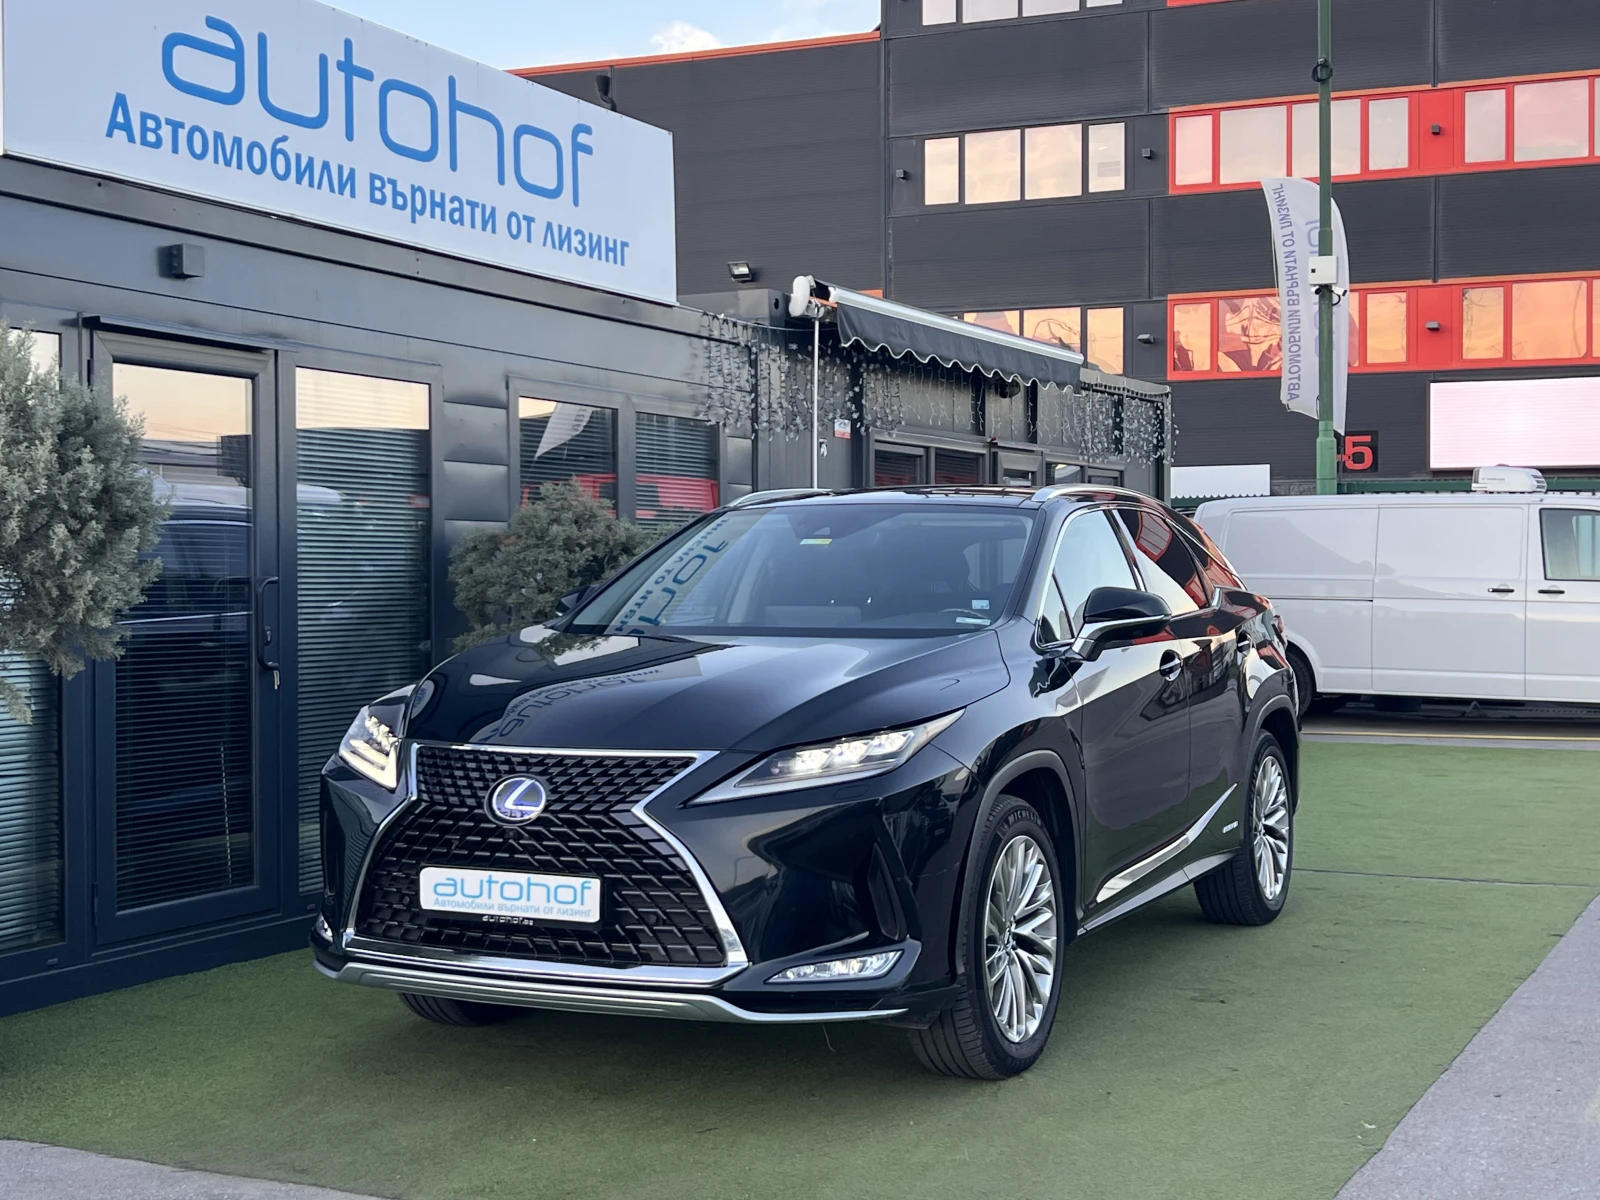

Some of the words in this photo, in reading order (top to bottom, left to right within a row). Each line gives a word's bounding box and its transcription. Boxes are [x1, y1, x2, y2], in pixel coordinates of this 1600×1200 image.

[161, 15, 593, 207] autohof
[105, 92, 356, 199] Автомобили
[369, 172, 497, 236] върнати
[506, 211, 536, 243] от
[542, 221, 630, 267] лизинг
[433, 874, 592, 906] autohof
[433, 897, 495, 911] Автомобили
[497, 903, 540, 914] върнати
[543, 906, 554, 914] от
[557, 907, 592, 918] лизинг
